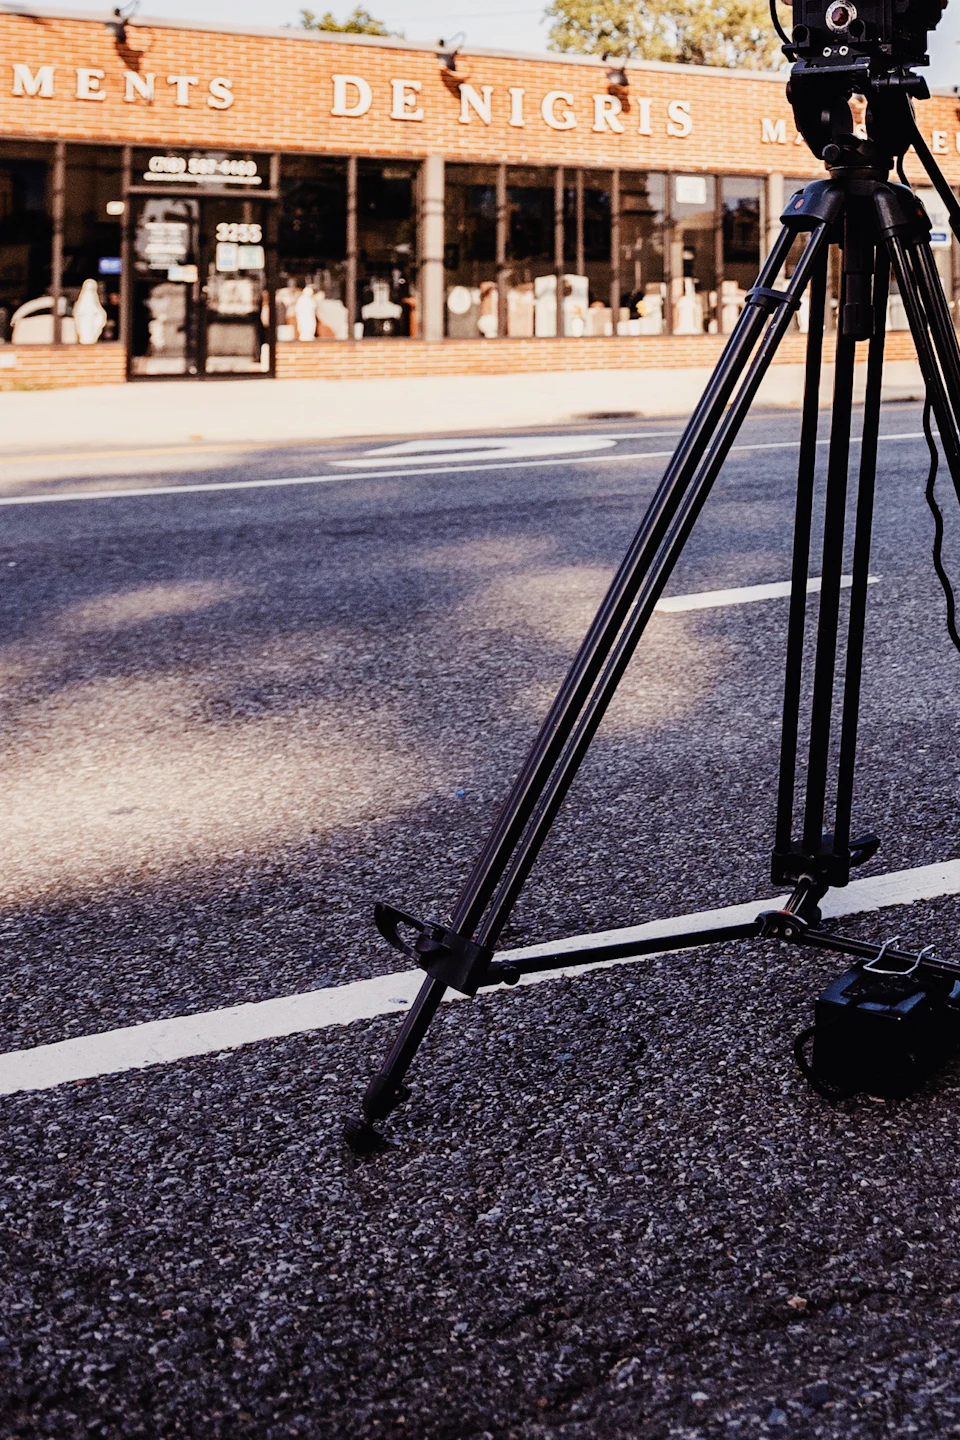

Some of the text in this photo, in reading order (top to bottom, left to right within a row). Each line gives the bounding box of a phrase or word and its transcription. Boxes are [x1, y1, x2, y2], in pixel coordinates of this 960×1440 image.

[12, 63, 234, 109] MENTS
[331, 74, 693, 138] DE NIGRIS
